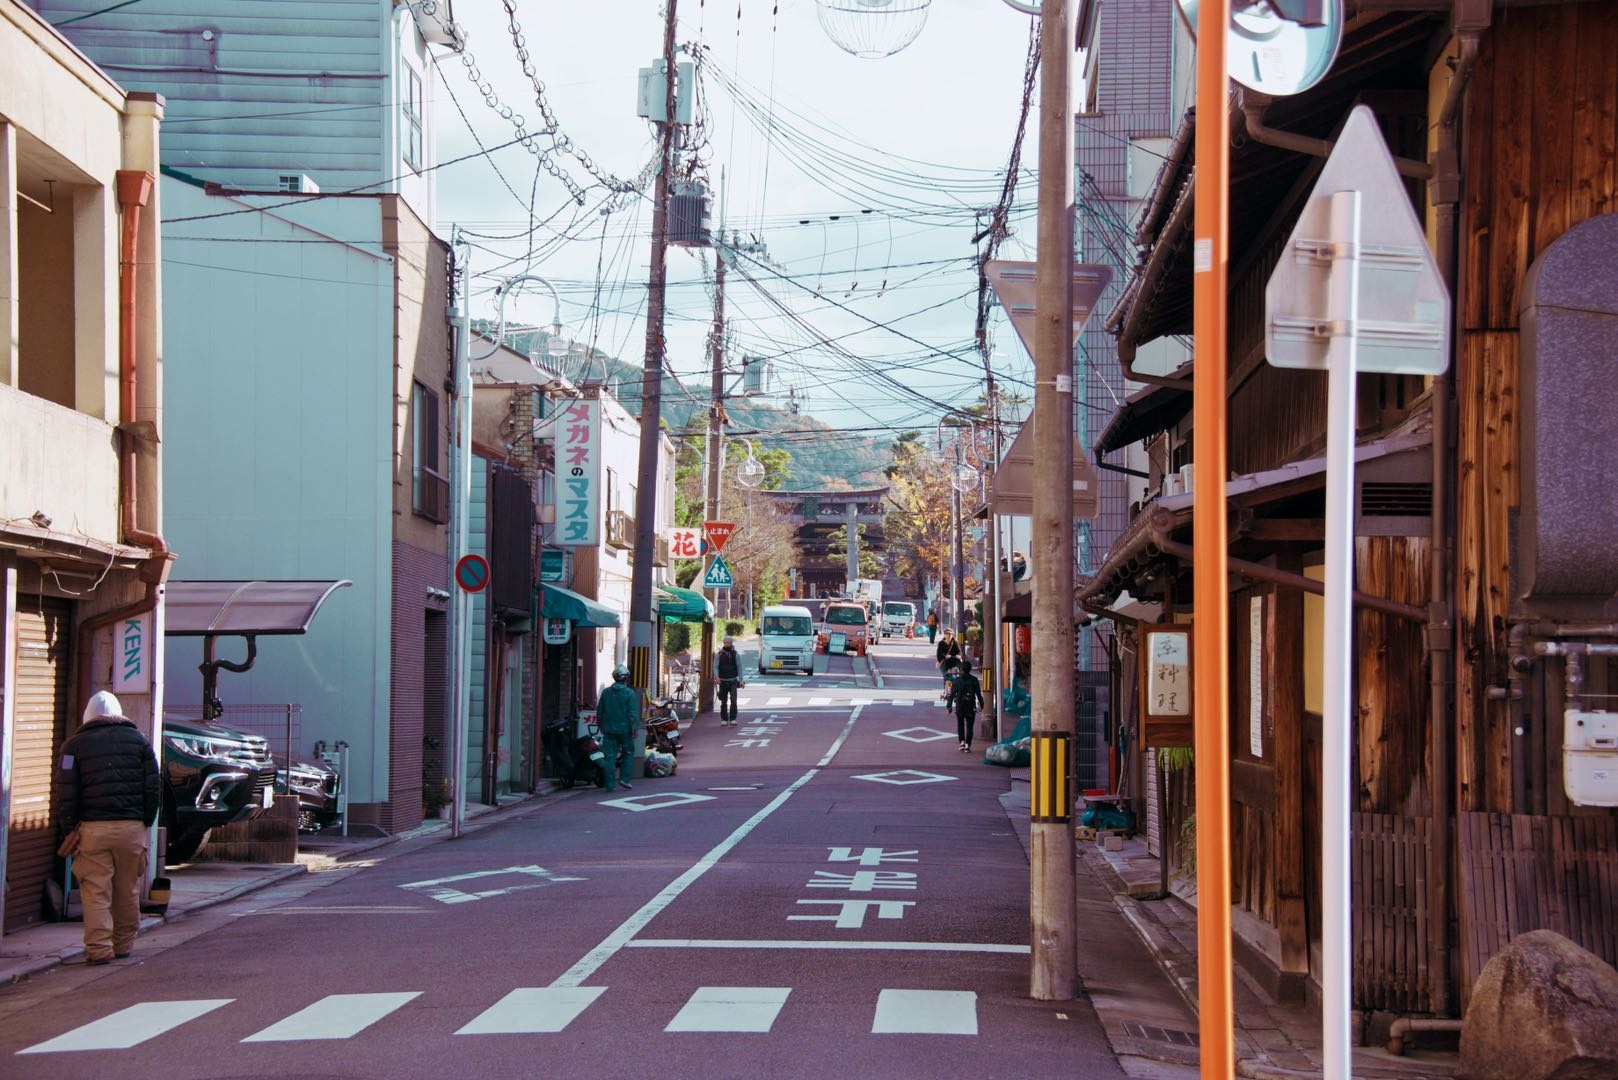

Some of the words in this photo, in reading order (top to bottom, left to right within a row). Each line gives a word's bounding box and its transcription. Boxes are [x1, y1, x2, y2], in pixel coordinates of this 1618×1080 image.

[565, 404, 590, 541] メガネのマスダ
[671, 532, 697, 556] 花
[124, 619, 142, 681] KENT
[1157, 636, 1180, 712] 京料理
[723, 714, 793, 748] 止まれ
[786, 847, 919, 929] 止まれ
